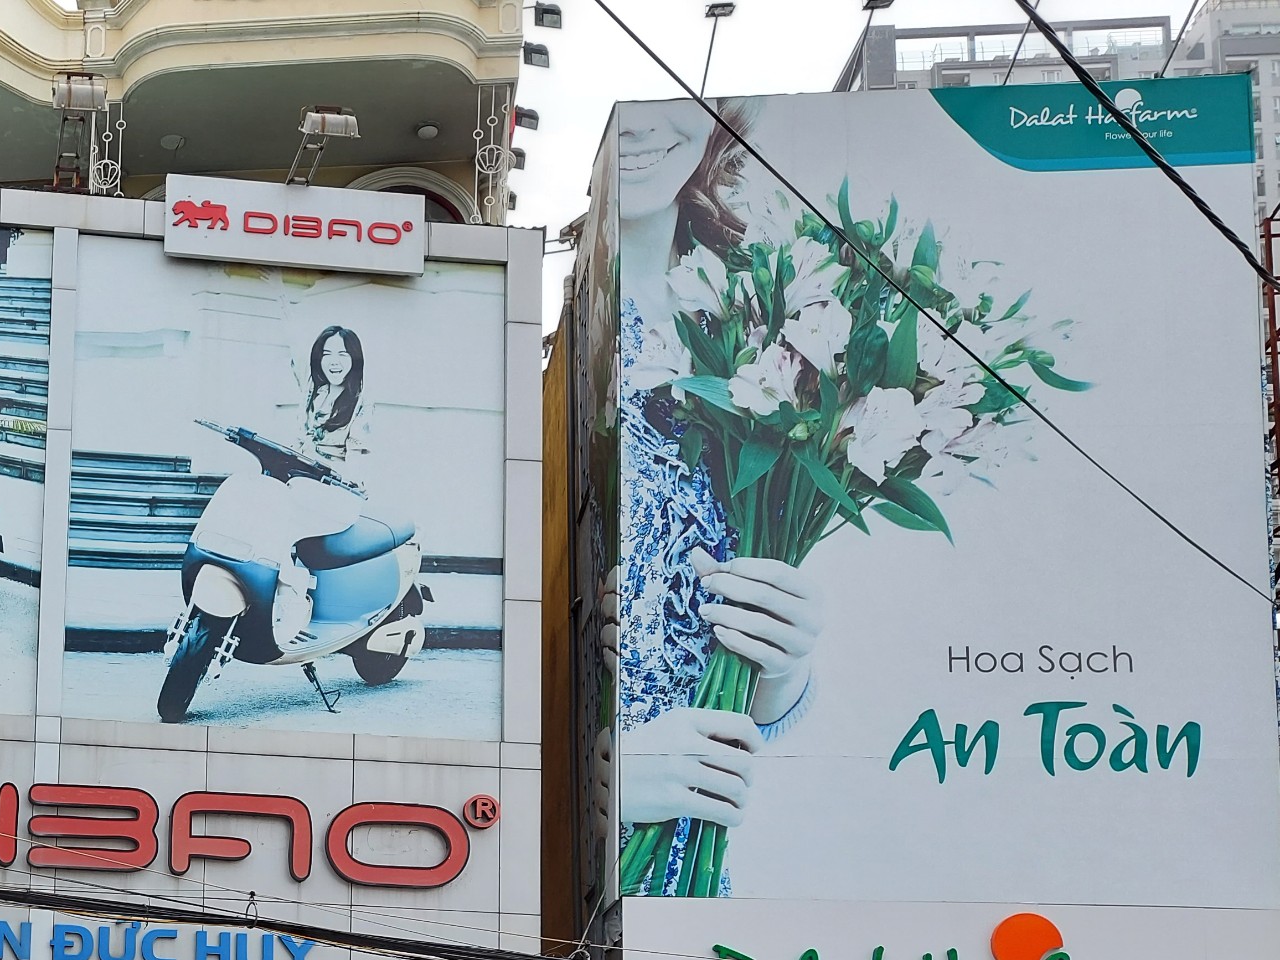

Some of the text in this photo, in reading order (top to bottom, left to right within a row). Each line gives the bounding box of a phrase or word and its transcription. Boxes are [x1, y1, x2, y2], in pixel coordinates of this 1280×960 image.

[1009, 104, 1077, 129] Dalat
[1105, 131, 1134, 141] Flowe
[1159, 129, 1173, 138] life
[243, 211, 402, 244] DIBAO
[948, 645, 1134, 680] Hoa Sạch
[888, 701, 1201, 784] An Toàn
